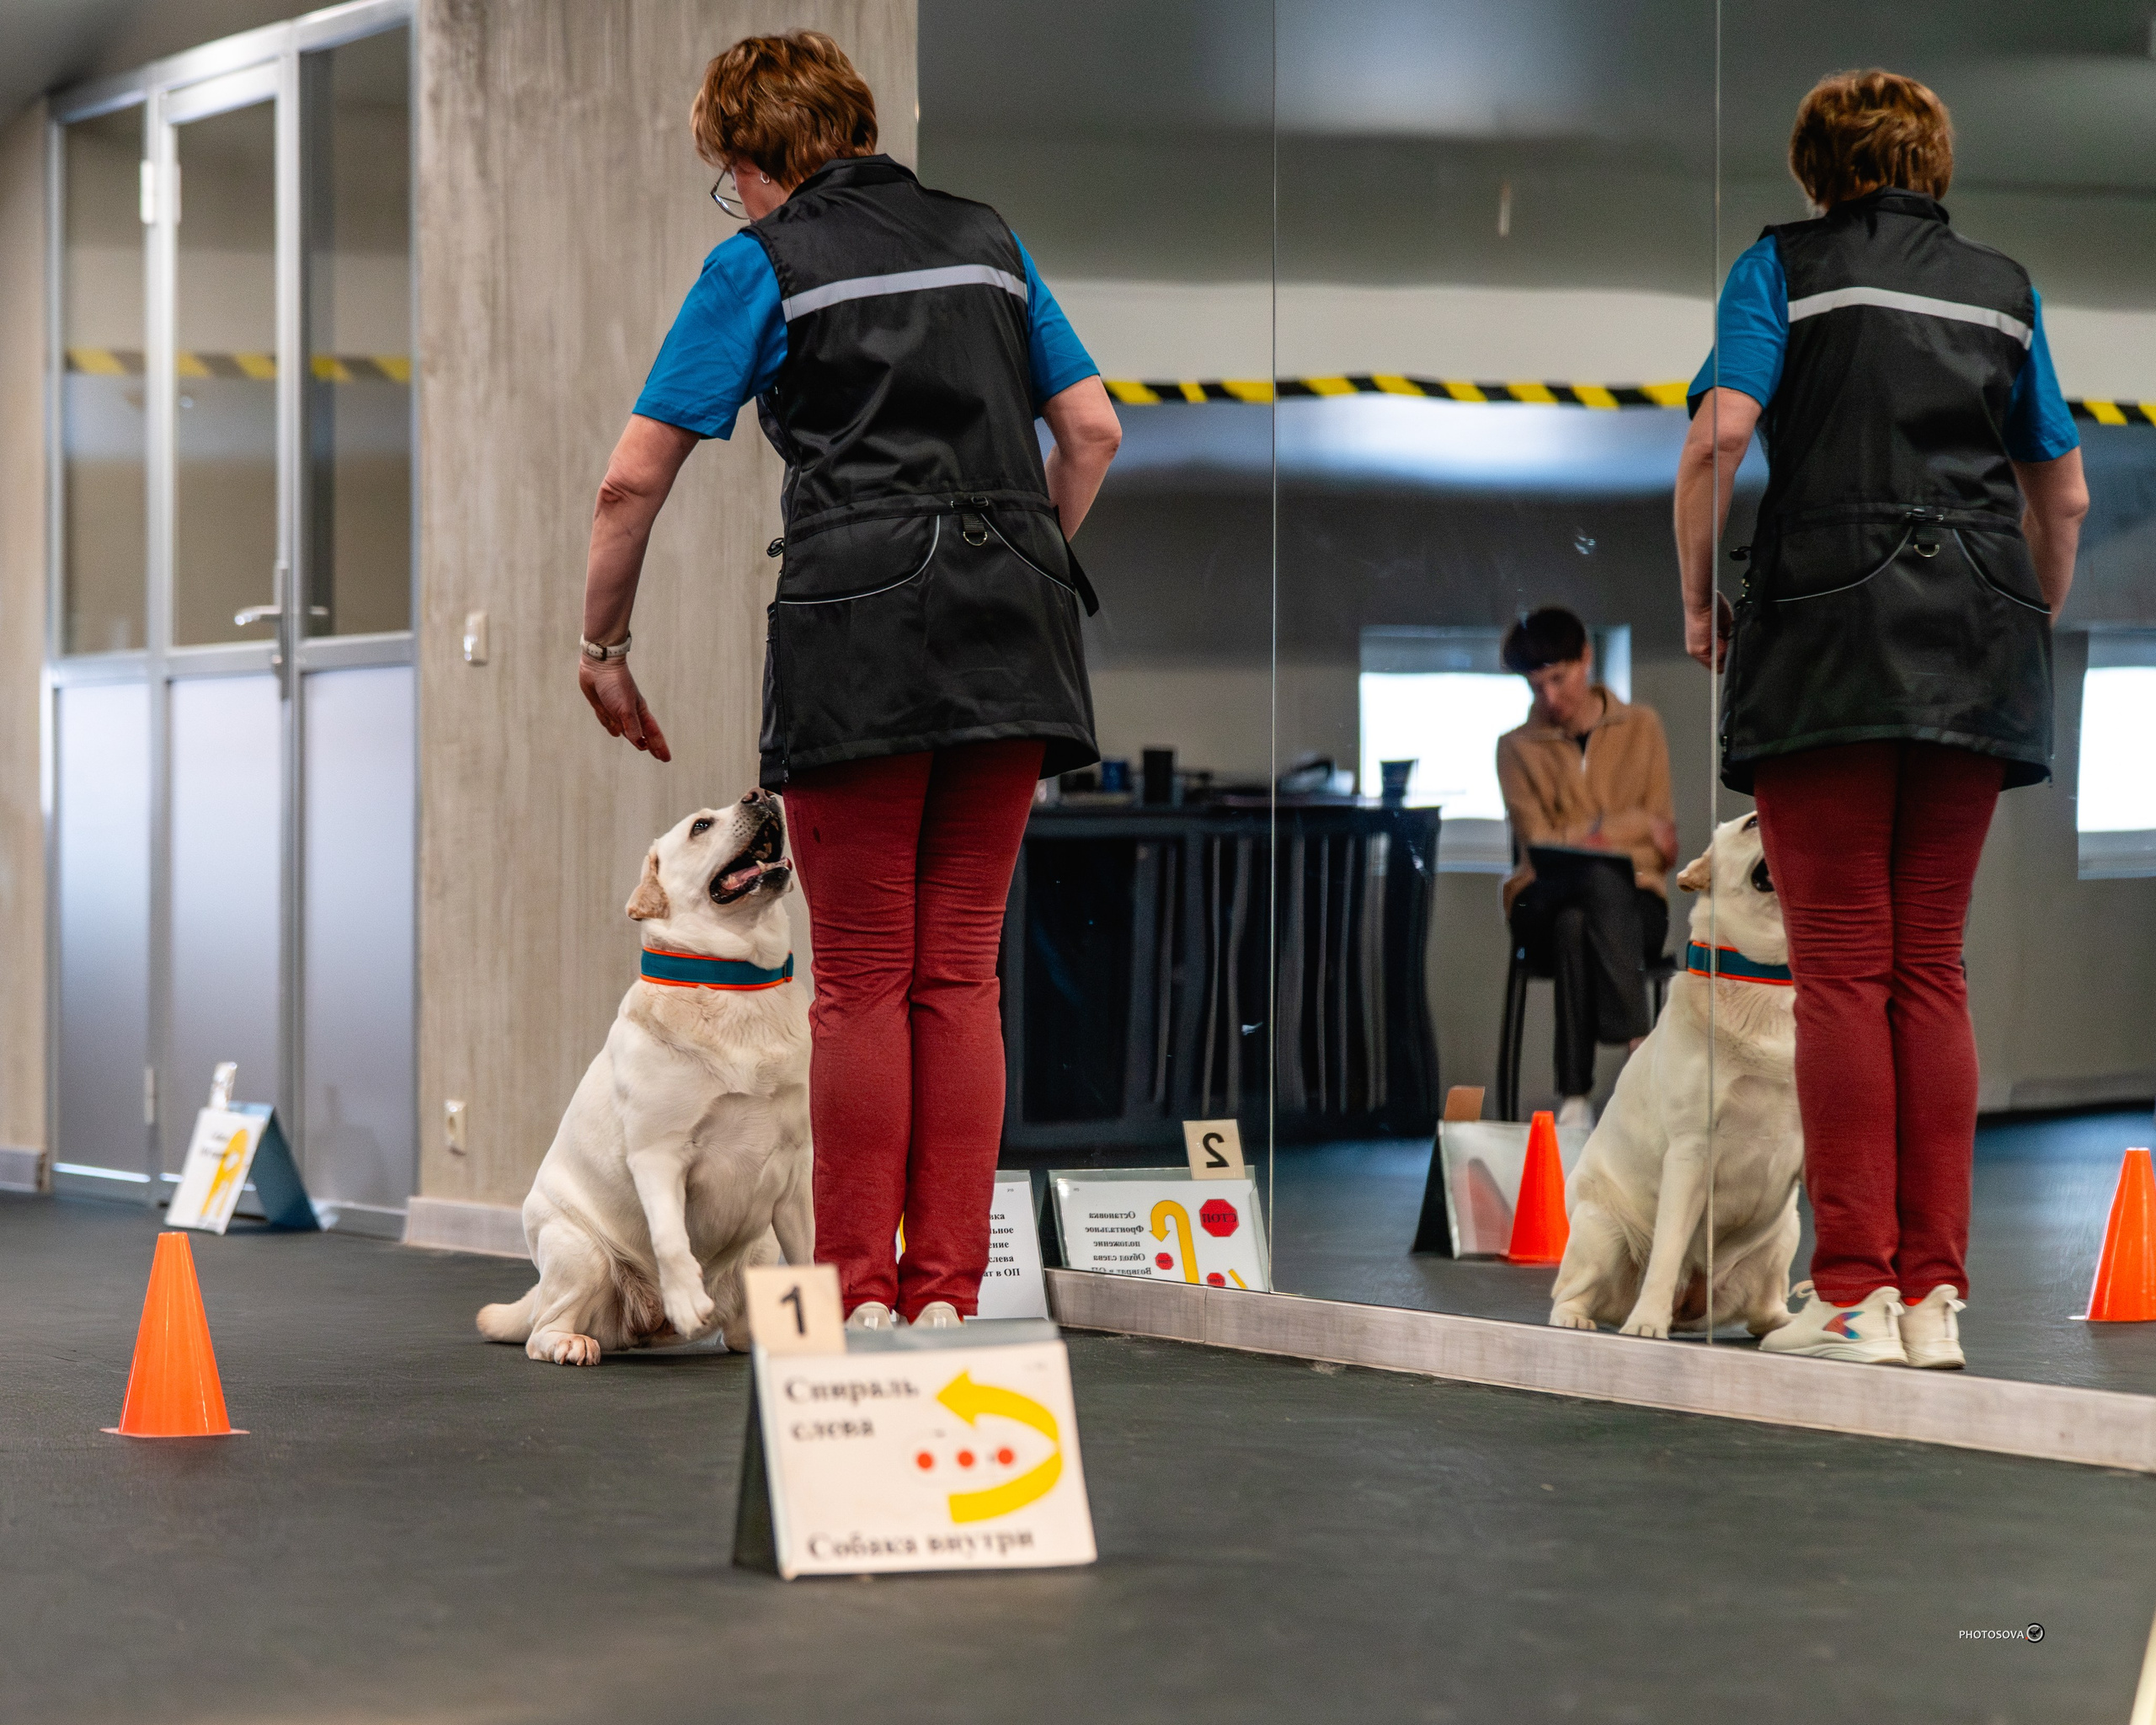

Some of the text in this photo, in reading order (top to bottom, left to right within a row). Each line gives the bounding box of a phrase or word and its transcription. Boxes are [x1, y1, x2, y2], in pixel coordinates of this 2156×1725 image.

[1004, 1268, 1020, 1277] ОП
[780, 1285, 807, 1337] 1
[785, 1376, 919, 1405] Спираль
[791, 1418, 874, 1440] слева
[807, 1530, 1033, 1561] Собака внутри
